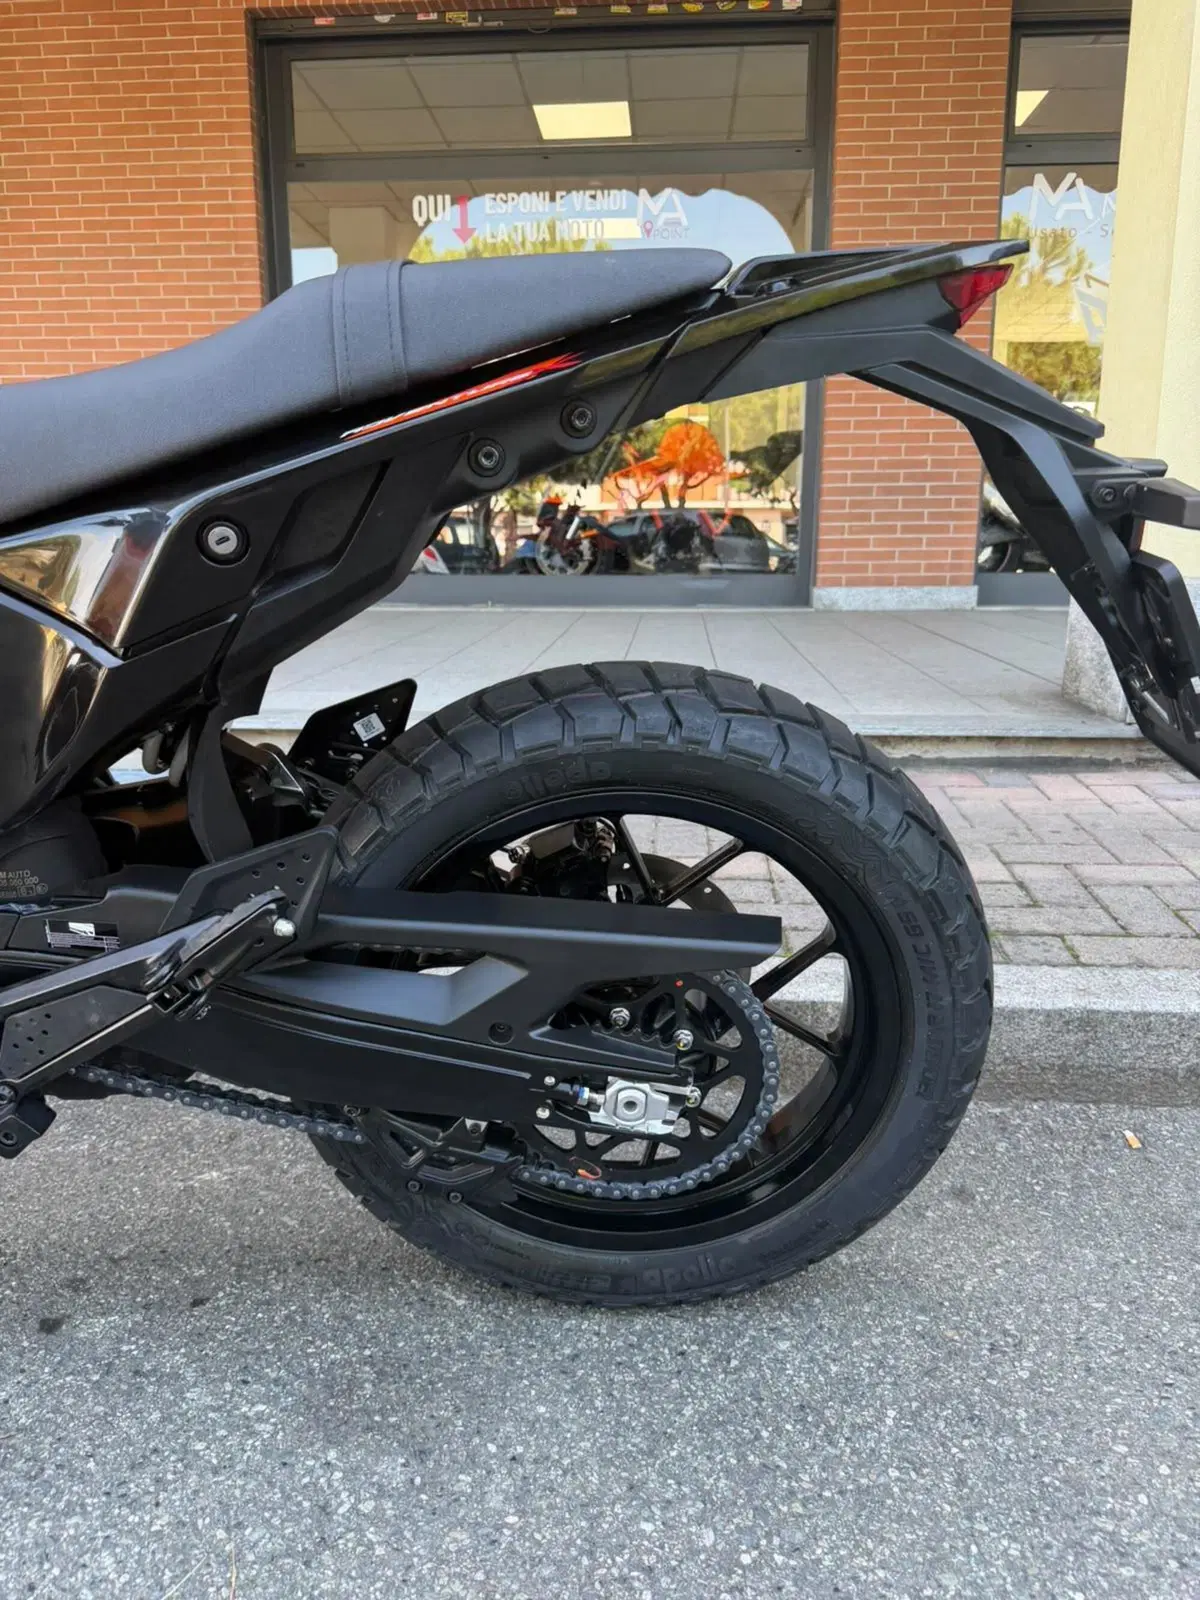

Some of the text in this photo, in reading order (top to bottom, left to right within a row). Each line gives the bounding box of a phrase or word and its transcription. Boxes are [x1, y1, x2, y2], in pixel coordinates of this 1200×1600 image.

[411, 194, 451, 226] QUI
[485, 188, 627, 215] ESPONI E VENDI
[485, 217, 605, 243] LA TUA MOTO
[653, 227, 690, 240] POINT
[8, 870, 31, 879] AUTO
